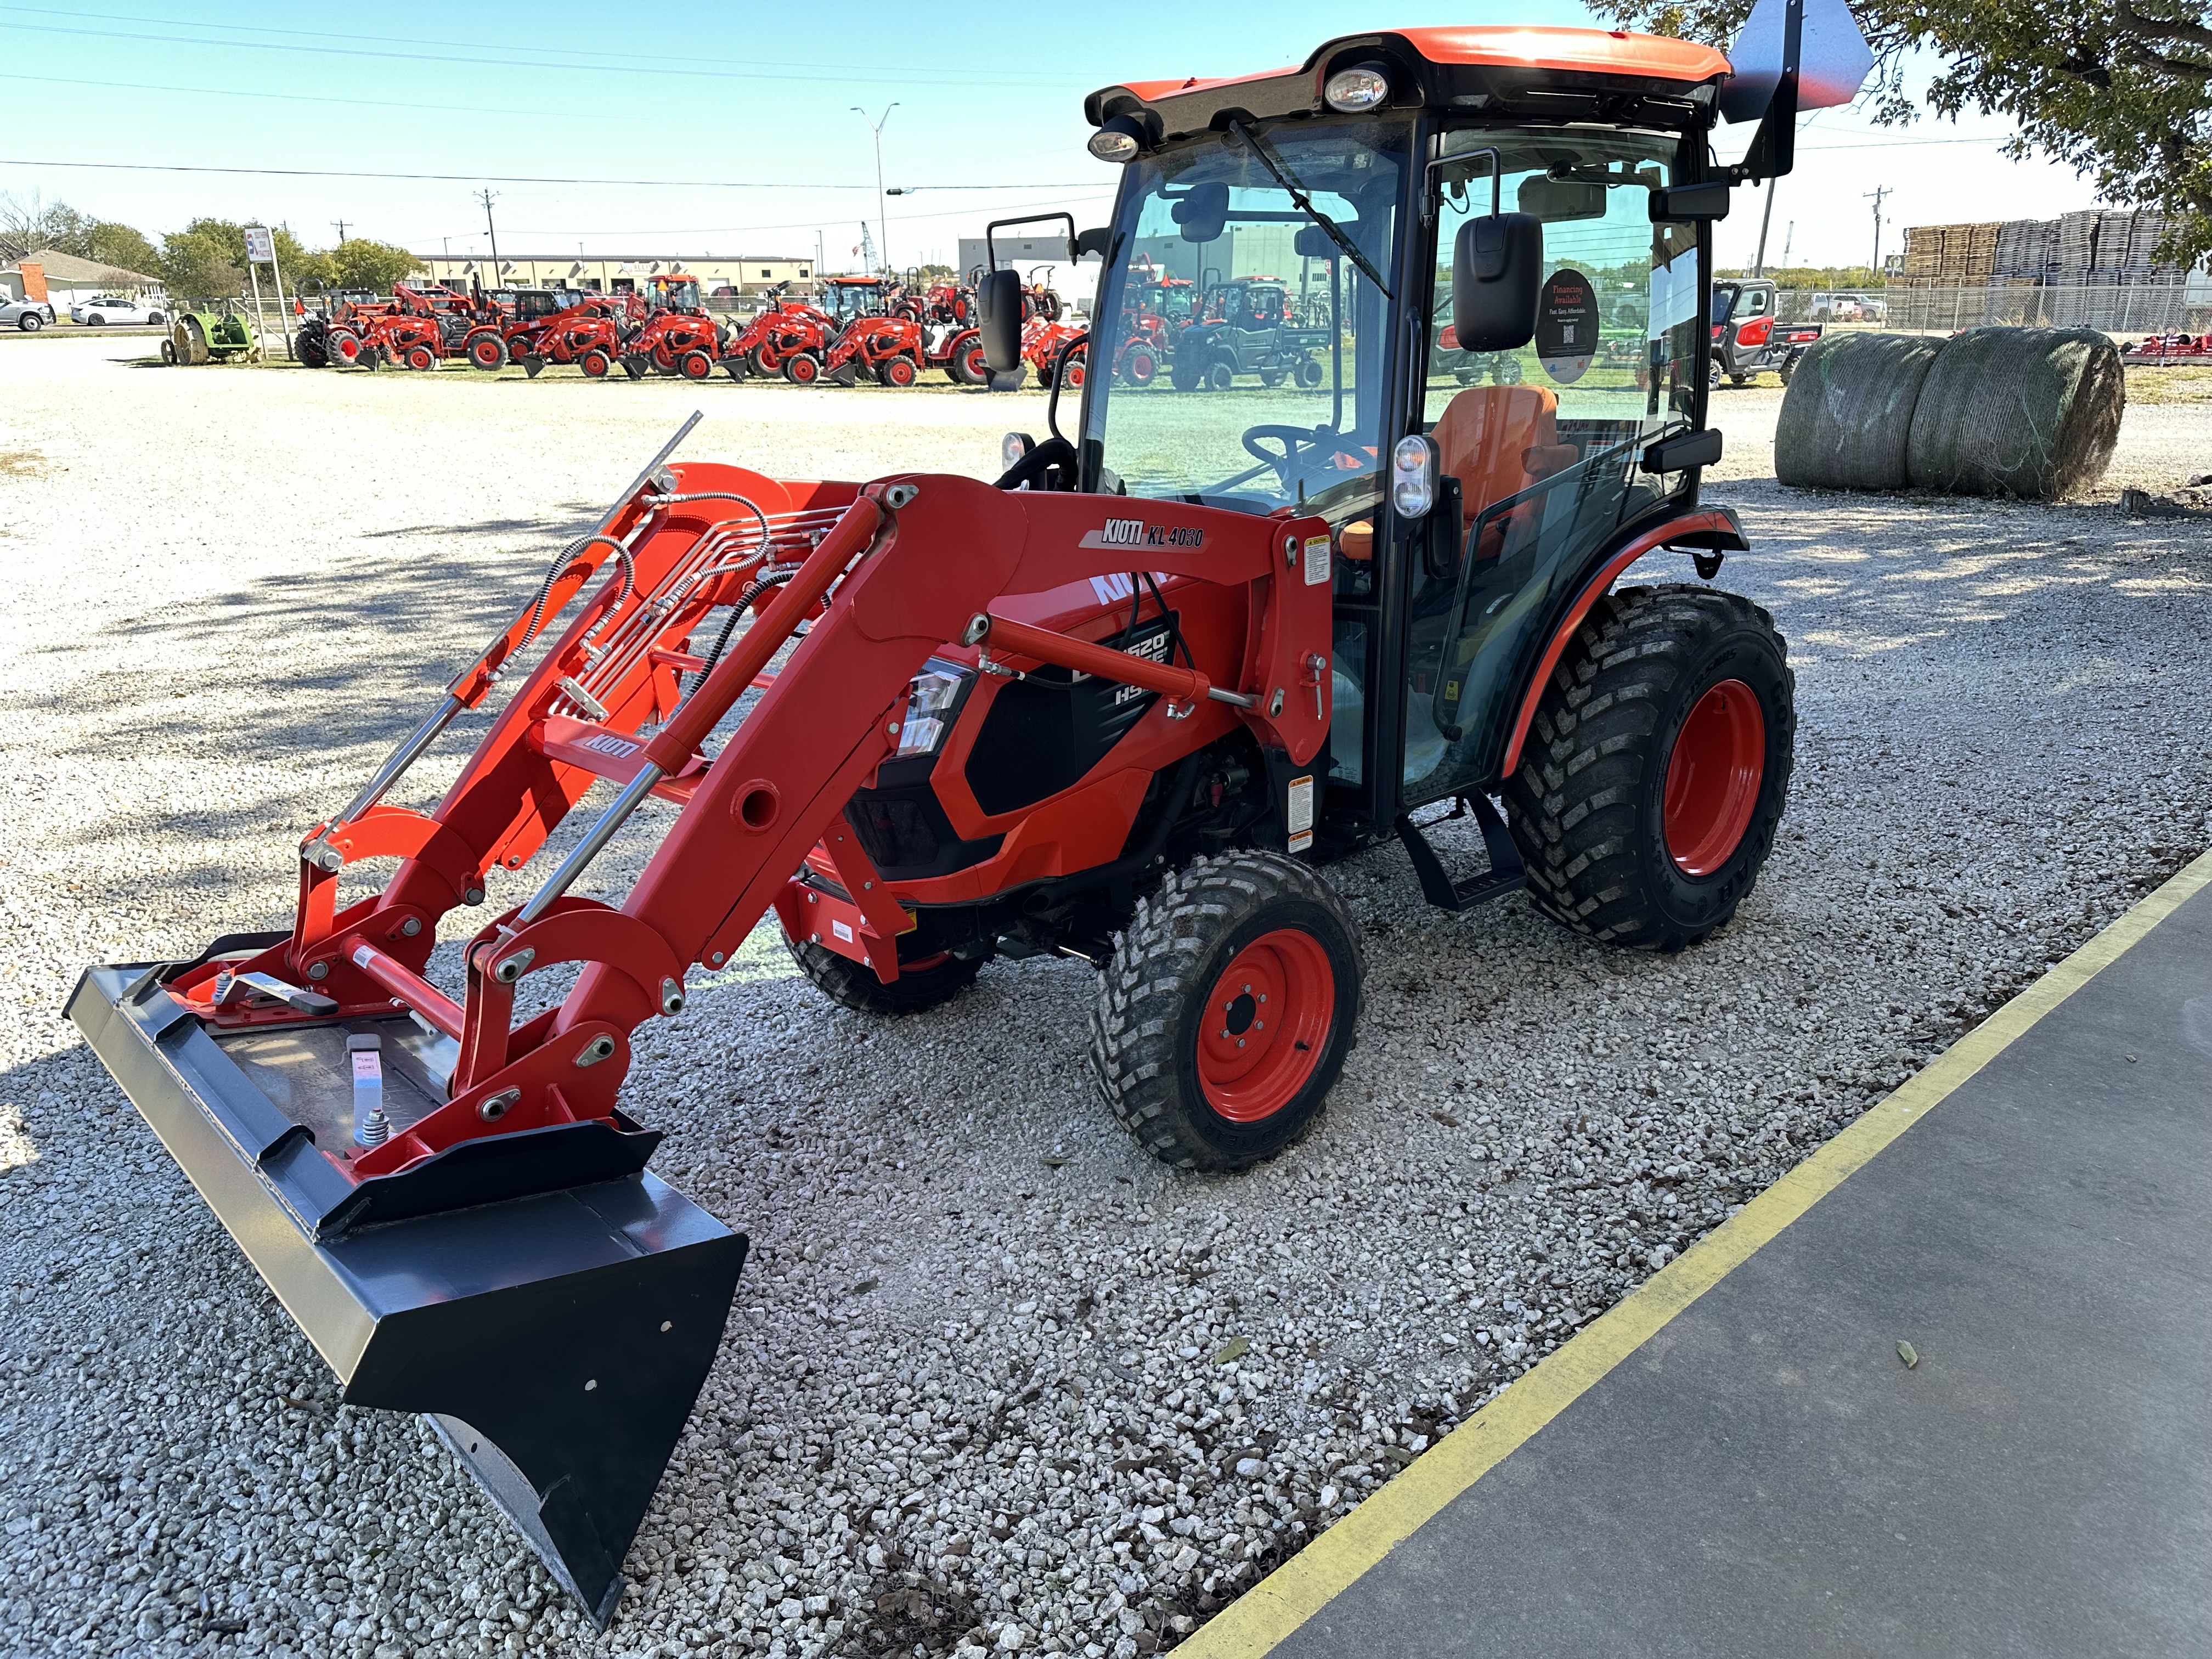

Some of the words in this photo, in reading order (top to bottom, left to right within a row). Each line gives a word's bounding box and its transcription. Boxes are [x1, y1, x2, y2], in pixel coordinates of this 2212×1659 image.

[1553, 285, 1583, 295] Financing
[1554, 295, 1582, 304] Available
[1102, 518, 1144, 545] KIOTI
[1147, 525, 1165, 546] KL
[1167, 527, 1204, 548] 4030
[1123, 632, 1165, 657] 520
[1115, 686, 1152, 705] HS
[584, 732, 641, 759] KIOTI
[1718, 680, 1788, 904] GOODYEAR
[1203, 1105, 1306, 1149] GOODYEAR
